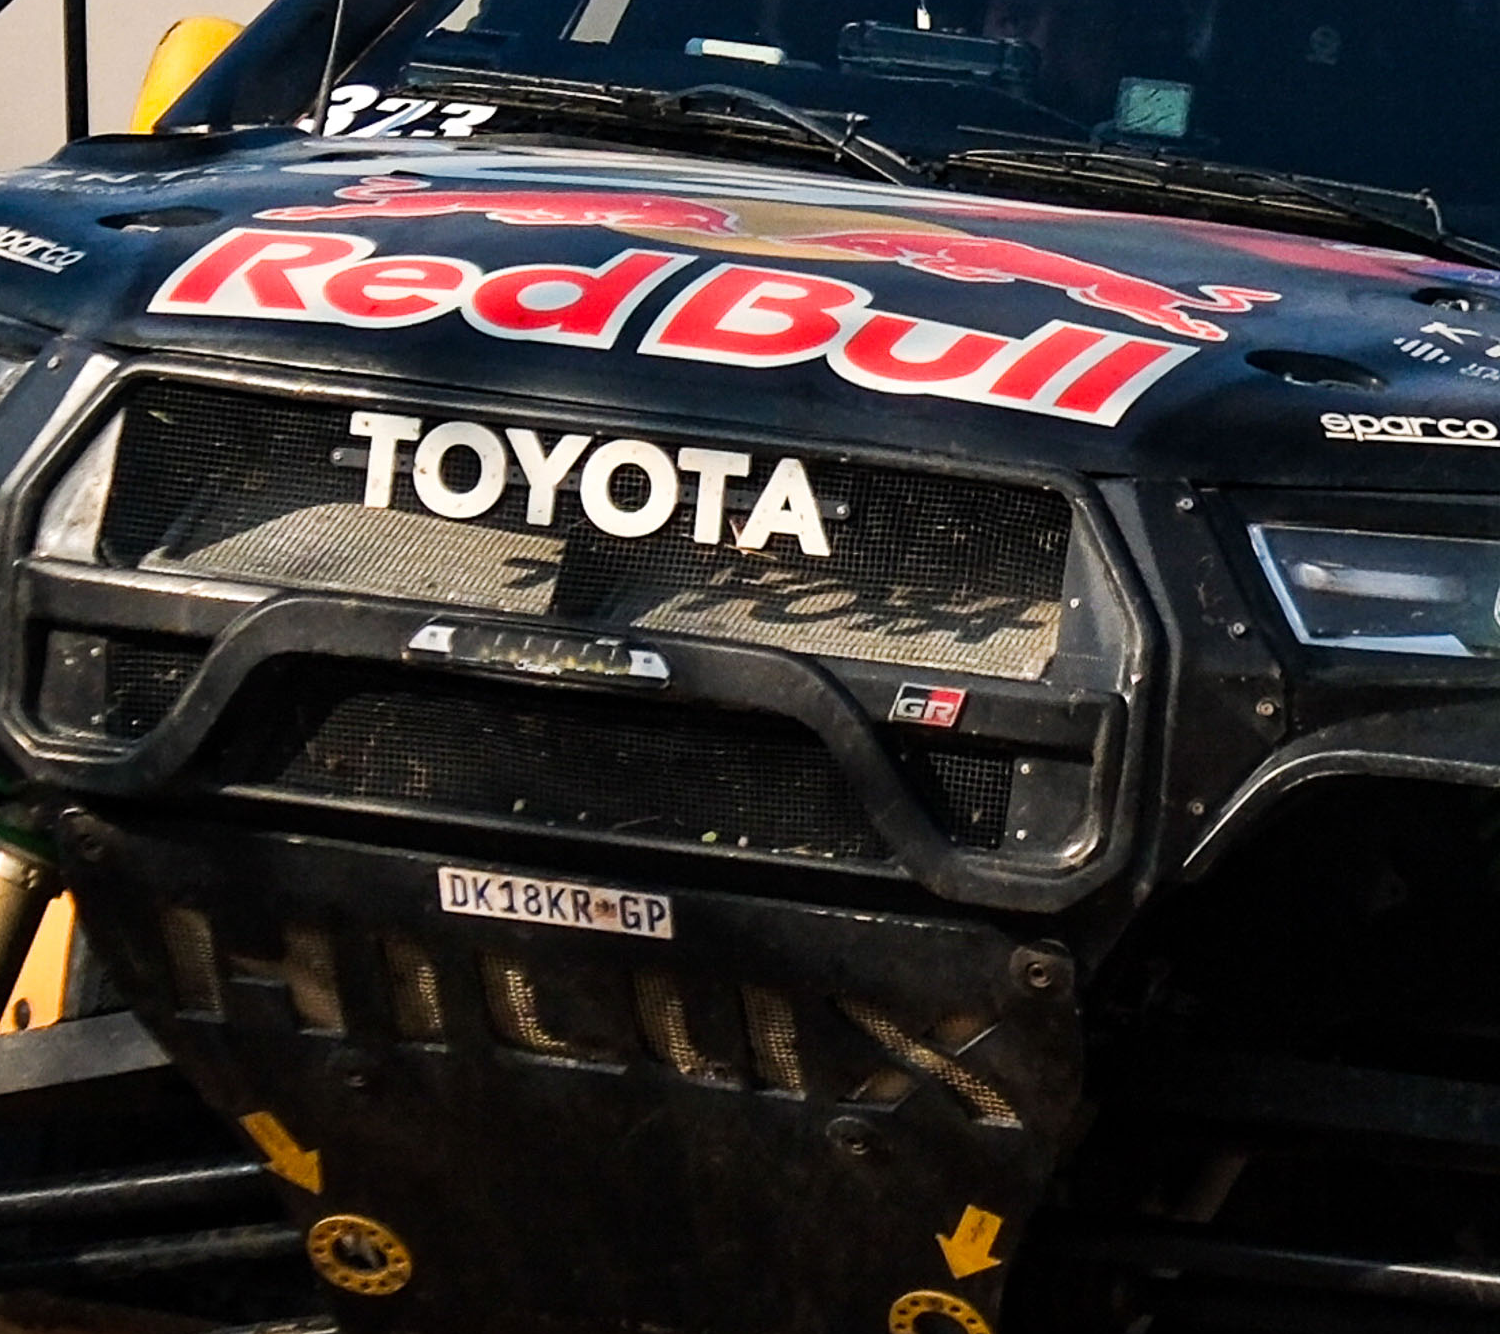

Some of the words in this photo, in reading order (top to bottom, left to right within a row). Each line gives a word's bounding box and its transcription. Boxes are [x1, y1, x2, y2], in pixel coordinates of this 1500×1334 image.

[148, 226, 699, 350] Red
[636, 261, 1201, 429] Bull
[1319, 410, 1500, 446] sparco
[348, 409, 832, 558] TOYOTA
[449, 873, 594, 925] DK18KR
[618, 894, 667, 934] GP
